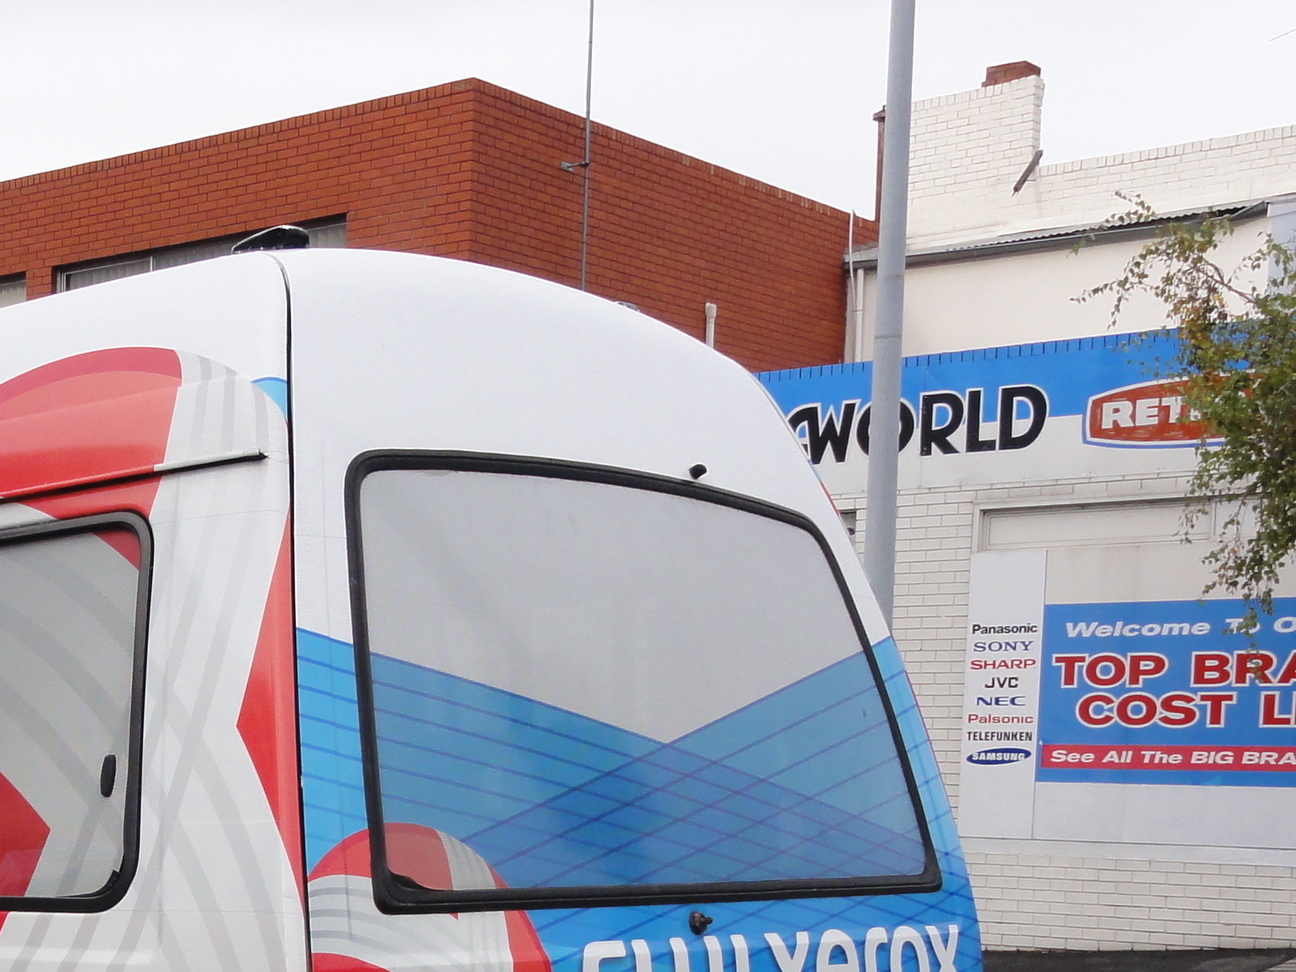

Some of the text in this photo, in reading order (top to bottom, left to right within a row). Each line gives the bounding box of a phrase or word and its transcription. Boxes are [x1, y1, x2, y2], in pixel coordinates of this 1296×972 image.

[971, 623, 1038, 634] Panasonic
[1065, 621, 1210, 637] Welcome
[973, 641, 1034, 652] SONY
[970, 659, 1036, 670] SHARP
[1052, 651, 1169, 688] TOP
[984, 676, 1019, 689] JVC
[976, 696, 1026, 706] NEC
[1075, 691, 1237, 728] COST
[967, 714, 1034, 724] Palsonic
[966, 731, 1033, 742] TELEFUNKEN
[971, 751, 1026, 761] SAMSUNG
[1050, 750, 1095, 763] See
[1102, 751, 1133, 764] All
[1141, 751, 1183, 764] The
[1190, 751, 1235, 764] BIG
